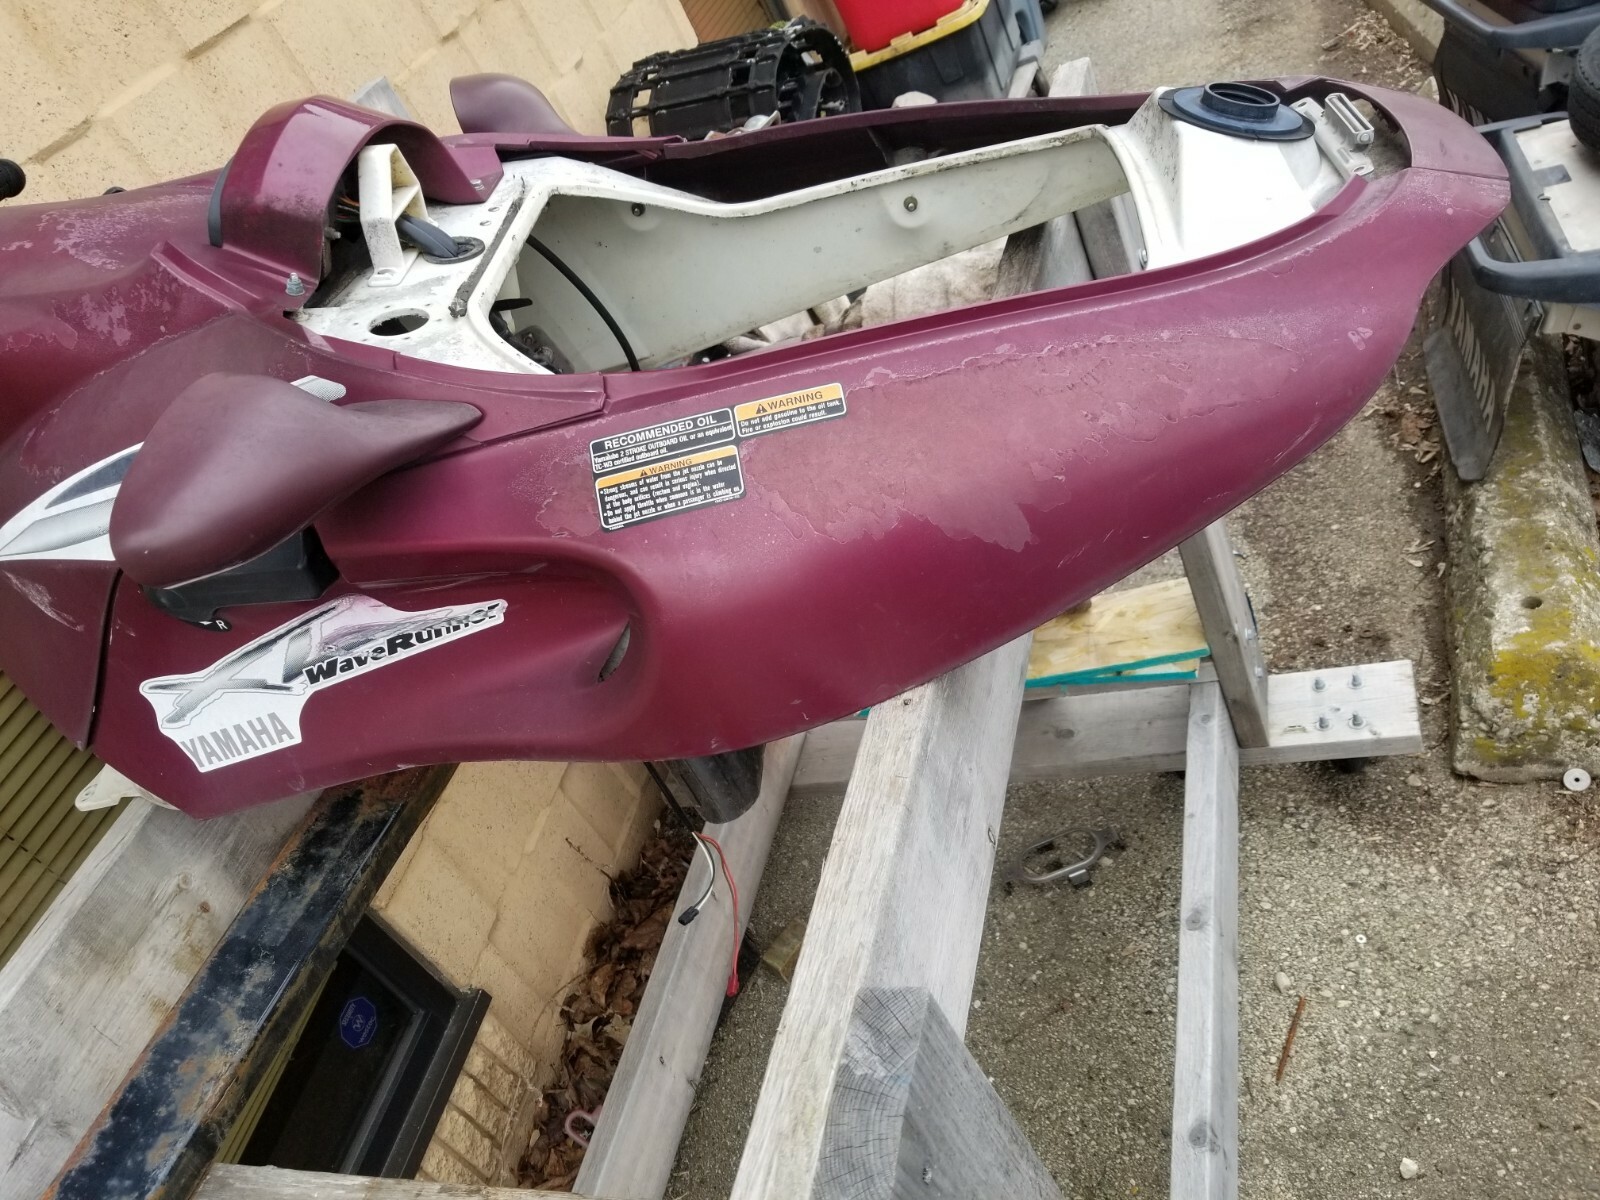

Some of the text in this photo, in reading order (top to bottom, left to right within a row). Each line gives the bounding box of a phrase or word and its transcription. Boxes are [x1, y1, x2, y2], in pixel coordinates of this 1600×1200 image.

[1450, 278, 1496, 434] YAMAHA
[768, 391, 823, 410] WARNING
[774, 409, 798, 420] gasoline
[827, 399, 841, 407] tank.
[763, 418, 790, 429] explosion
[792, 414, 806, 422] could
[809, 410, 827, 418] result.
[595, 452, 619, 463] Yamalube
[625, 445, 647, 455] STROKE
[648, 438, 677, 450] OUTBOARD
[705, 425, 732, 437] equivalent
[604, 415, 717, 450] RECOMMENDED OIL
[596, 461, 613, 470] TC-W3
[614, 455, 635, 465] certified
[636, 450, 658, 460] outboard
[650, 458, 692, 474] WARNING
[604, 486, 618, 495] Strong
[620, 481, 637, 490] streams
[691, 464, 705, 472] nozzle
[650, 482, 663, 490] result
[672, 476, 687, 484] serious
[690, 473, 702, 481] injury
[718, 464, 736, 473] directed
[622, 498, 633, 506] body
[634, 493, 651, 502] orifices
[652, 488, 671, 497] (rectum
[624, 505, 636, 513] apply
[637, 499, 654, 508] throttle
[656, 496, 667, 504] when
[669, 492, 688, 500] someone
[642, 507, 655, 515] nozzle
[683, 495, 705, 506] passenger
[713, 488, 732, 498] climbing
[216, 620, 228, 630] R
[306, 602, 502, 686] WaveRunner
[180, 712, 294, 768] YAMAHA
